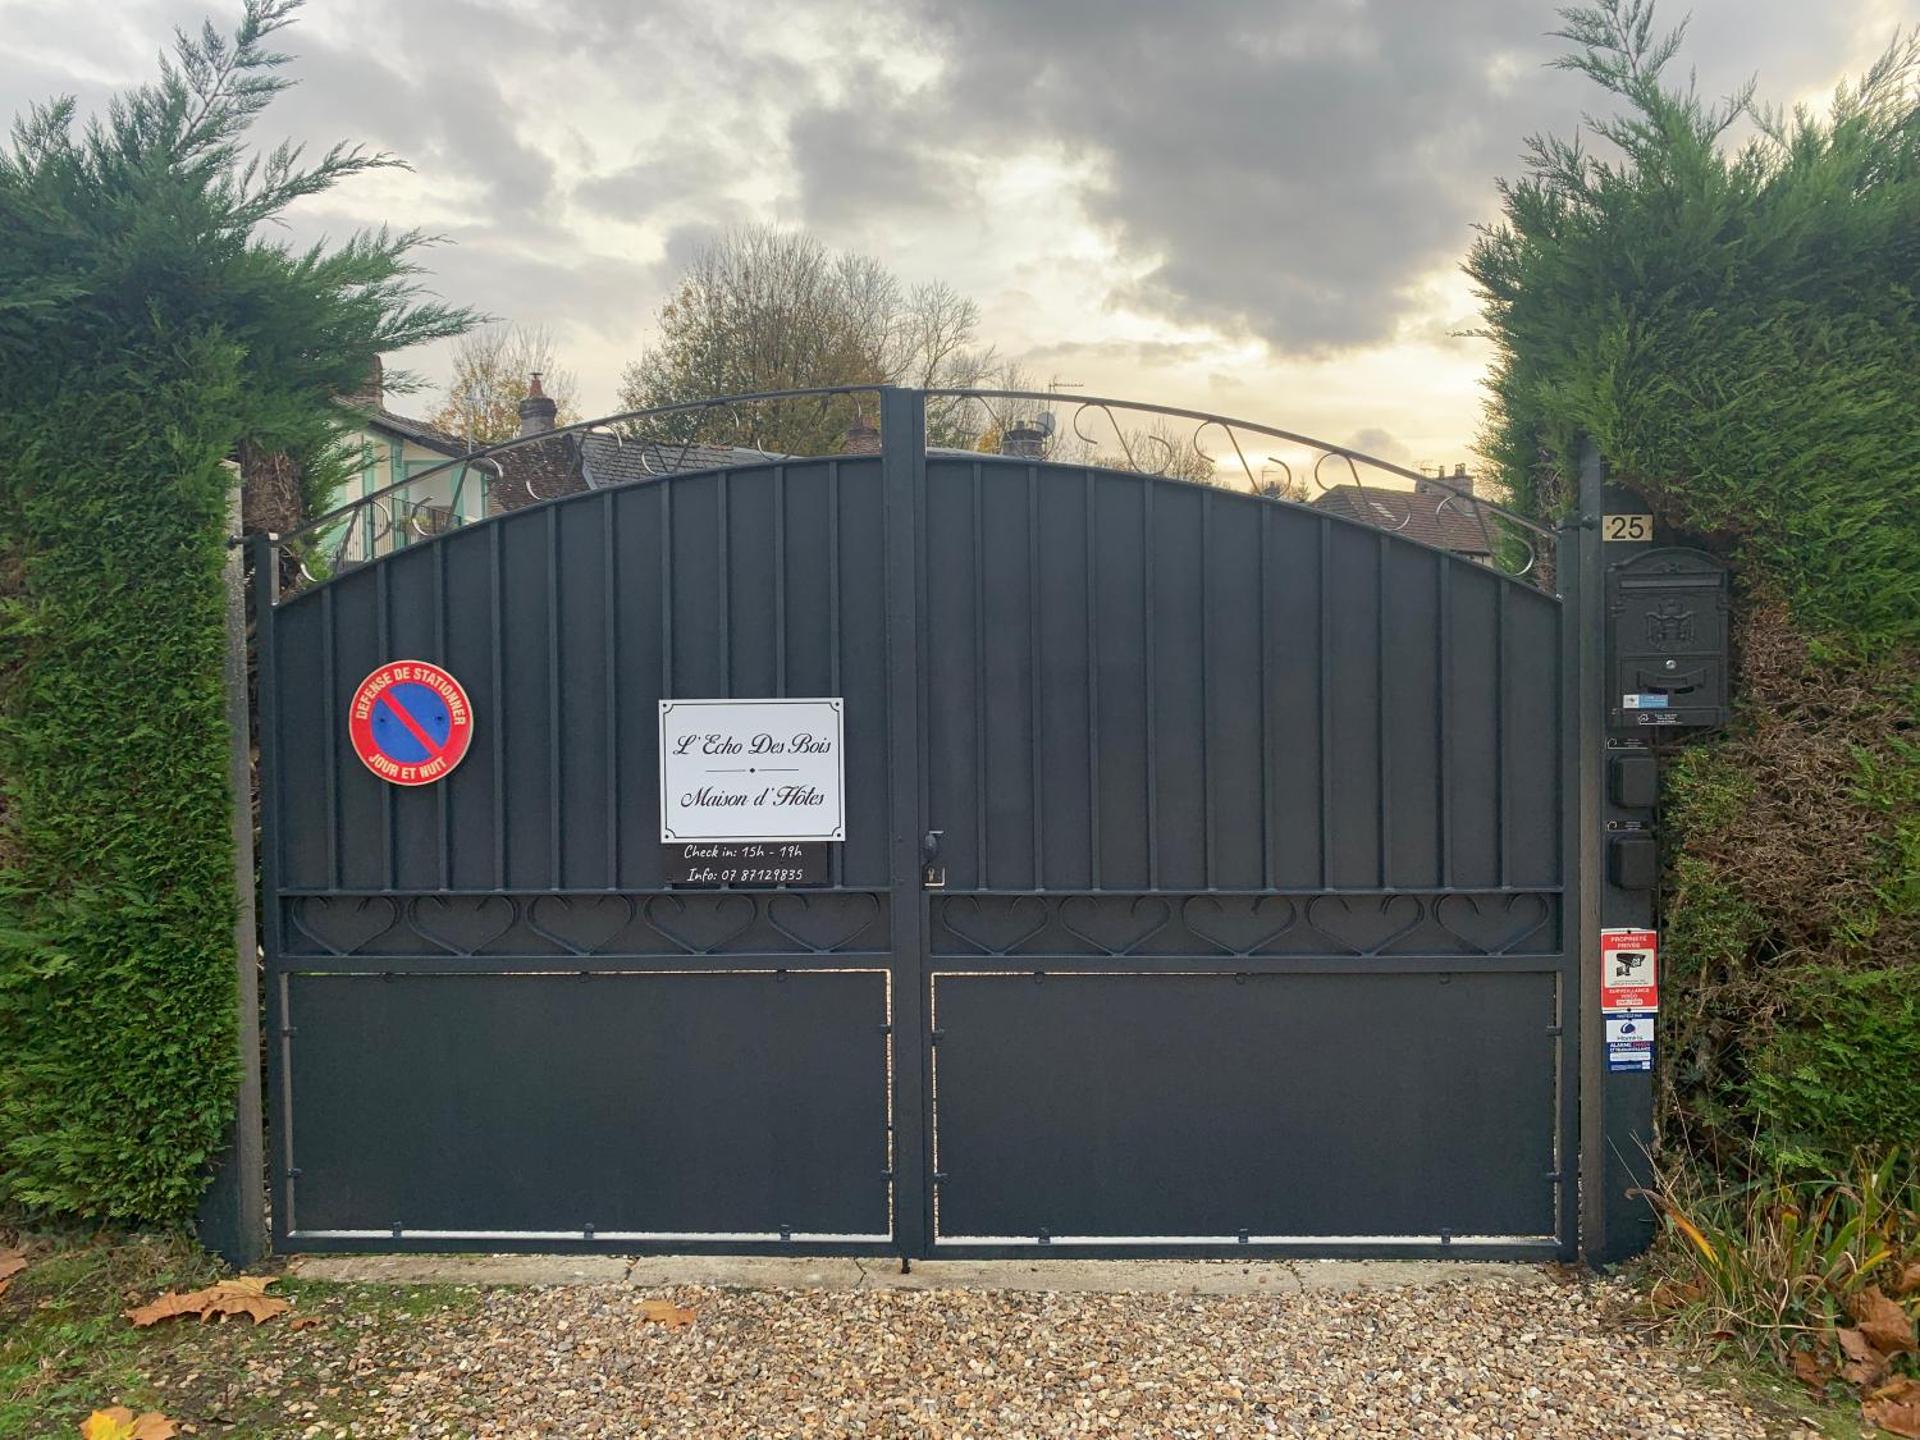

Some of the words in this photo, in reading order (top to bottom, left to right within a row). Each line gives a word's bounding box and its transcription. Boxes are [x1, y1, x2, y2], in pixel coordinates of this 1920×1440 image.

[1610, 516, 1645, 540] 25
[355, 671, 393, 720] DEFENSE
[393, 666, 410, 680] DE
[412, 667, 466, 726] STATIONNER
[748, 732, 785, 755] Des
[787, 732, 832, 754] Bois
[368, 753, 399, 777] JOUR
[401, 767, 416, 780] ET
[419, 756, 448, 778] NUIT
[680, 785, 749, 808] Maison
[753, 784, 825, 808] d'Hôtes
[683, 844, 718, 859] Check
[721, 846, 737, 858] in:
[741, 844, 765, 857] 15h
[779, 844, 802, 858] 19h
[686, 867, 718, 882] Info:
[721, 868, 737, 881] 07
[740, 868, 803, 882] 87129835
